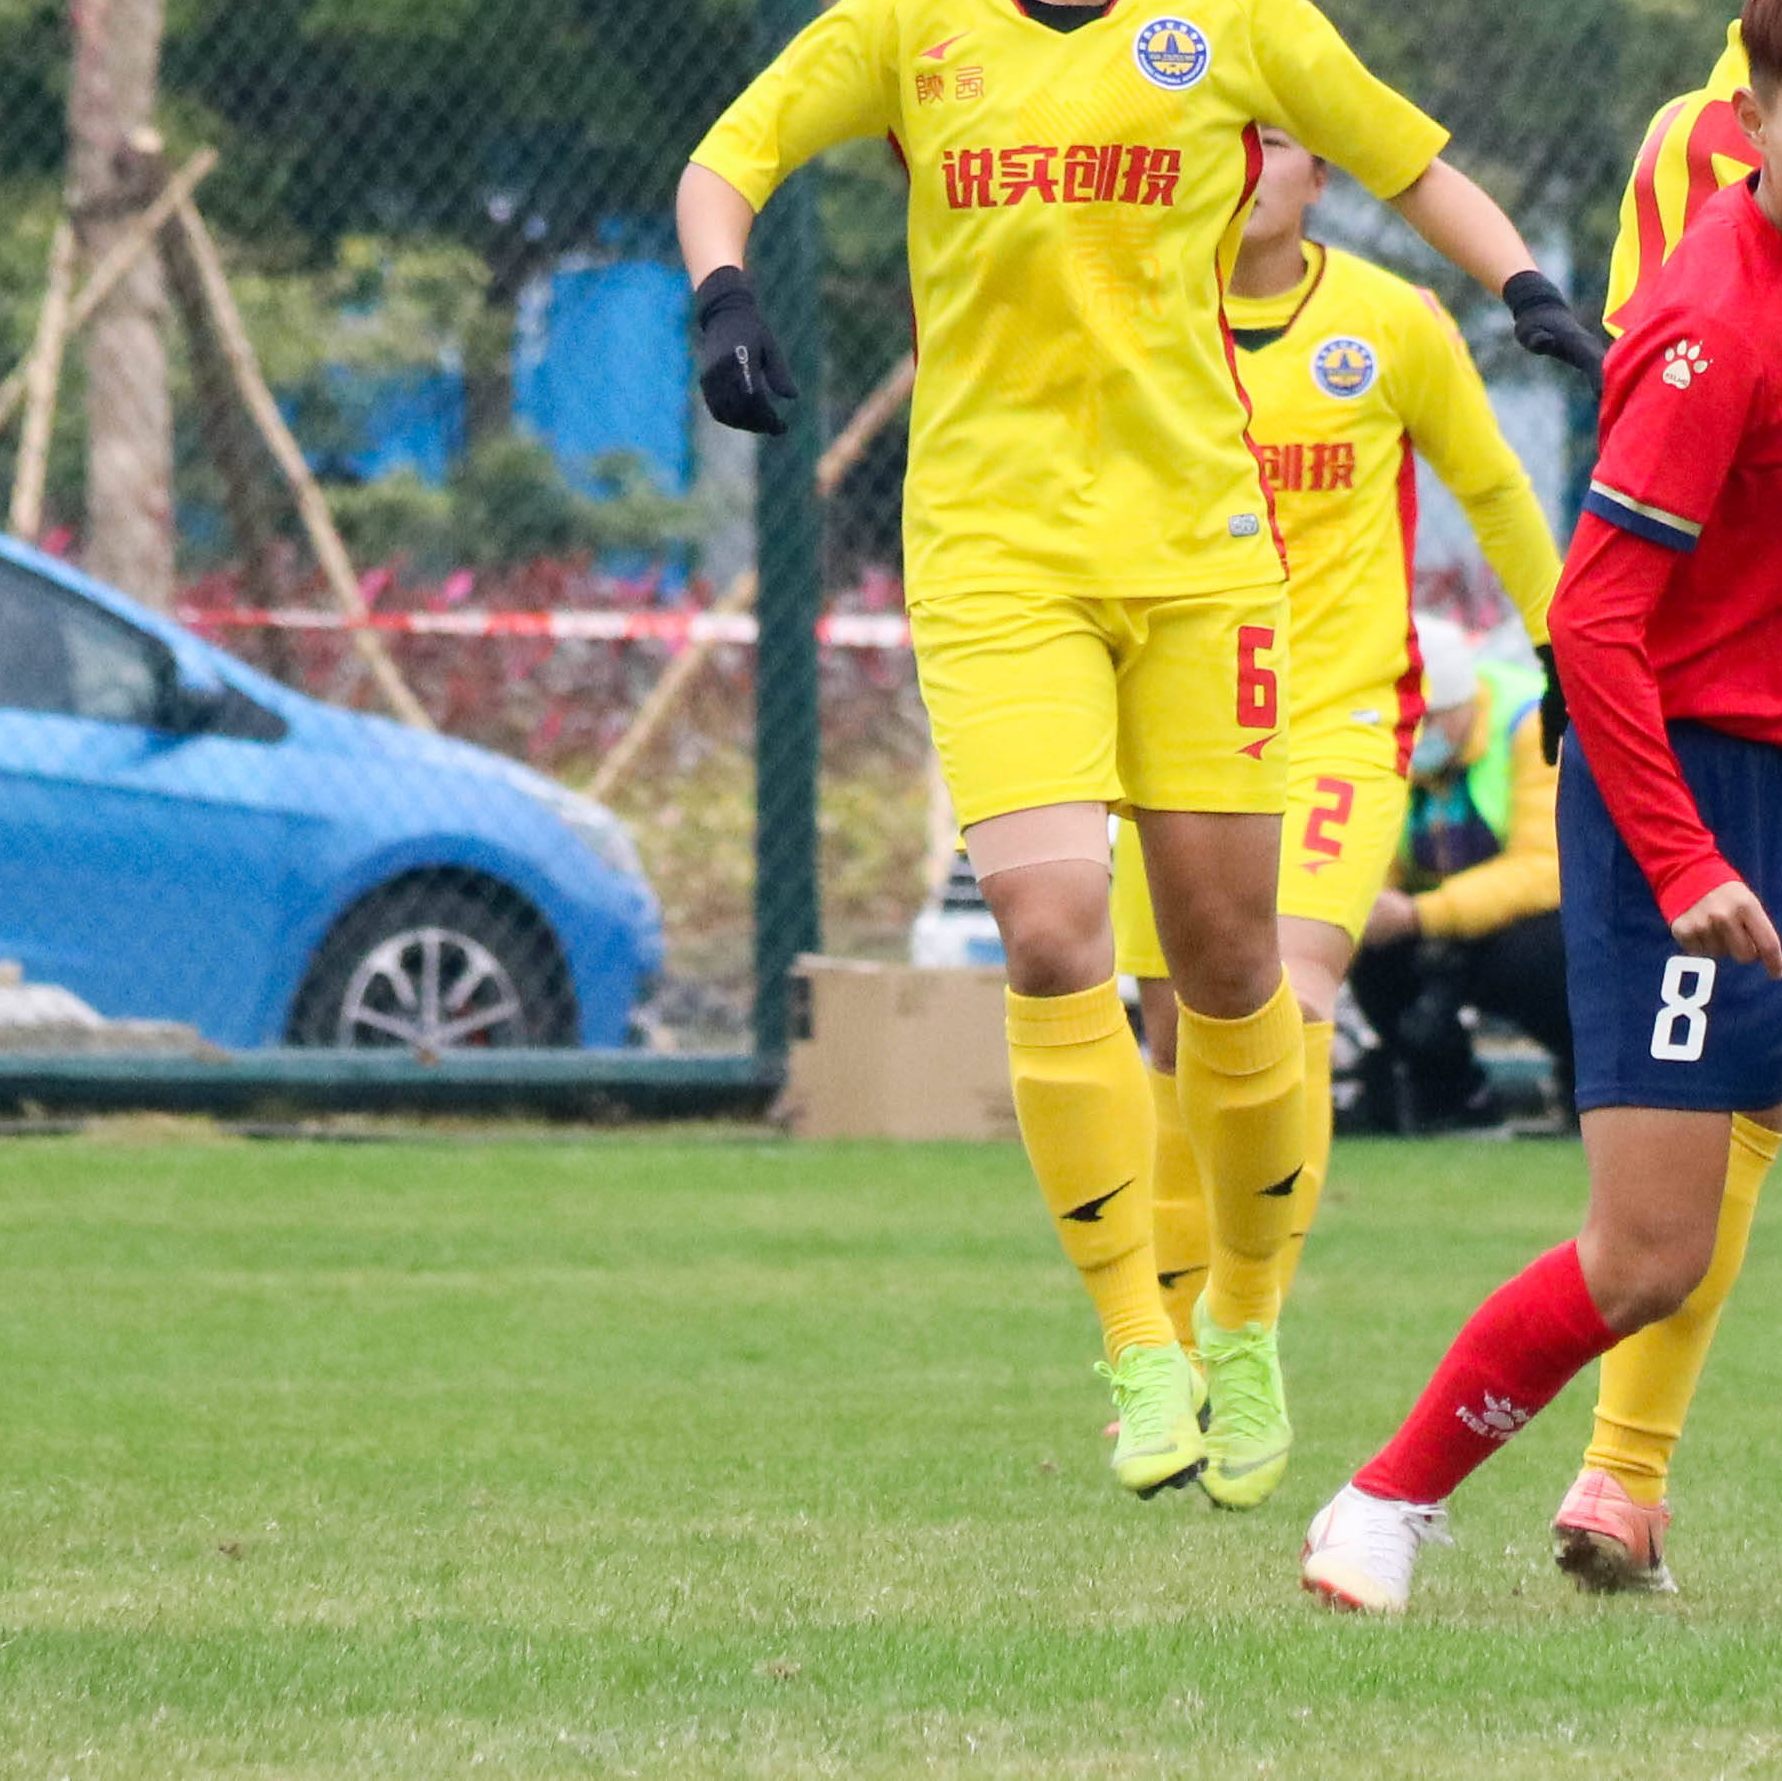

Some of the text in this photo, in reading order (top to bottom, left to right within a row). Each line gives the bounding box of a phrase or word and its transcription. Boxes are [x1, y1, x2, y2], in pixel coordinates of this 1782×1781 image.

[942, 144, 1181, 209] 说实创投
[1237, 625, 1278, 729] 6
[1301, 777, 1355, 859] 2
[1650, 956, 1717, 1063] 8
